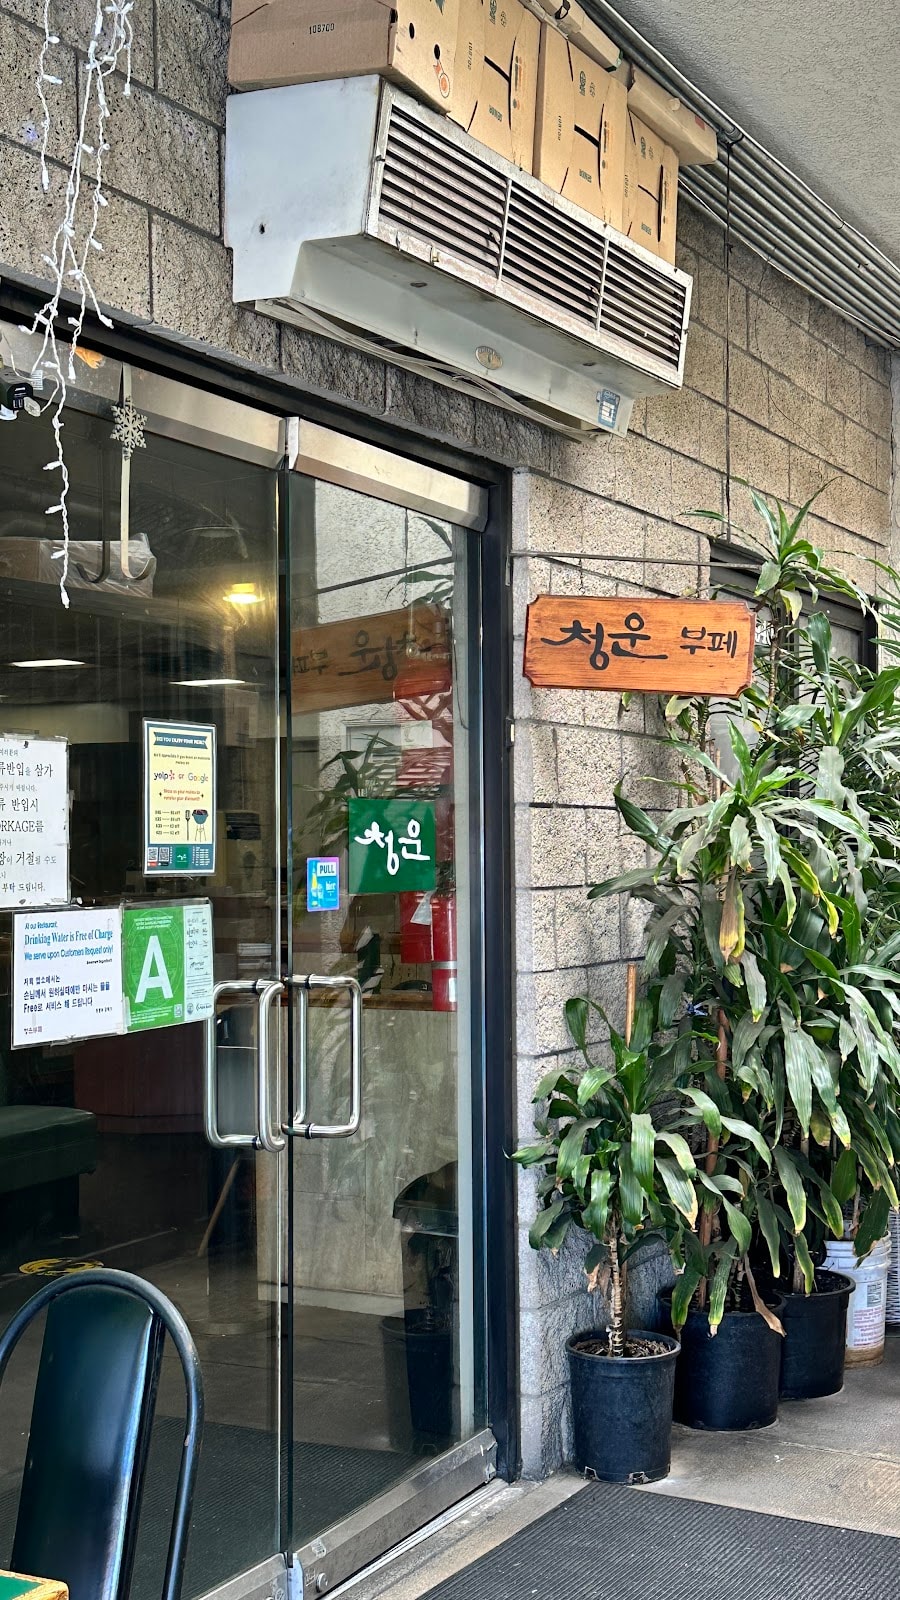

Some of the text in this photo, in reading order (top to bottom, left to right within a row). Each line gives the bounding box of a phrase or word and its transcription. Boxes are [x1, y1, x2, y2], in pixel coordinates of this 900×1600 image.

[539, 611, 669, 671] 청운
[679, 625, 738, 659] 부페
[34, 763, 54, 778] 삼가
[187, 772, 209, 784] Google
[11, 797, 39, 813] 반입시
[353, 818, 432, 877] 청운
[319, 864, 335, 874] PULL
[24, 928, 113, 947] Drinking Water is Free of Charge
[24, 952, 33, 961] We
[33, 952, 46, 960] serve
[47, 951, 60, 961] upon
[134, 935, 174, 1003] A
[45, 1000, 62, 1011] 서비스
